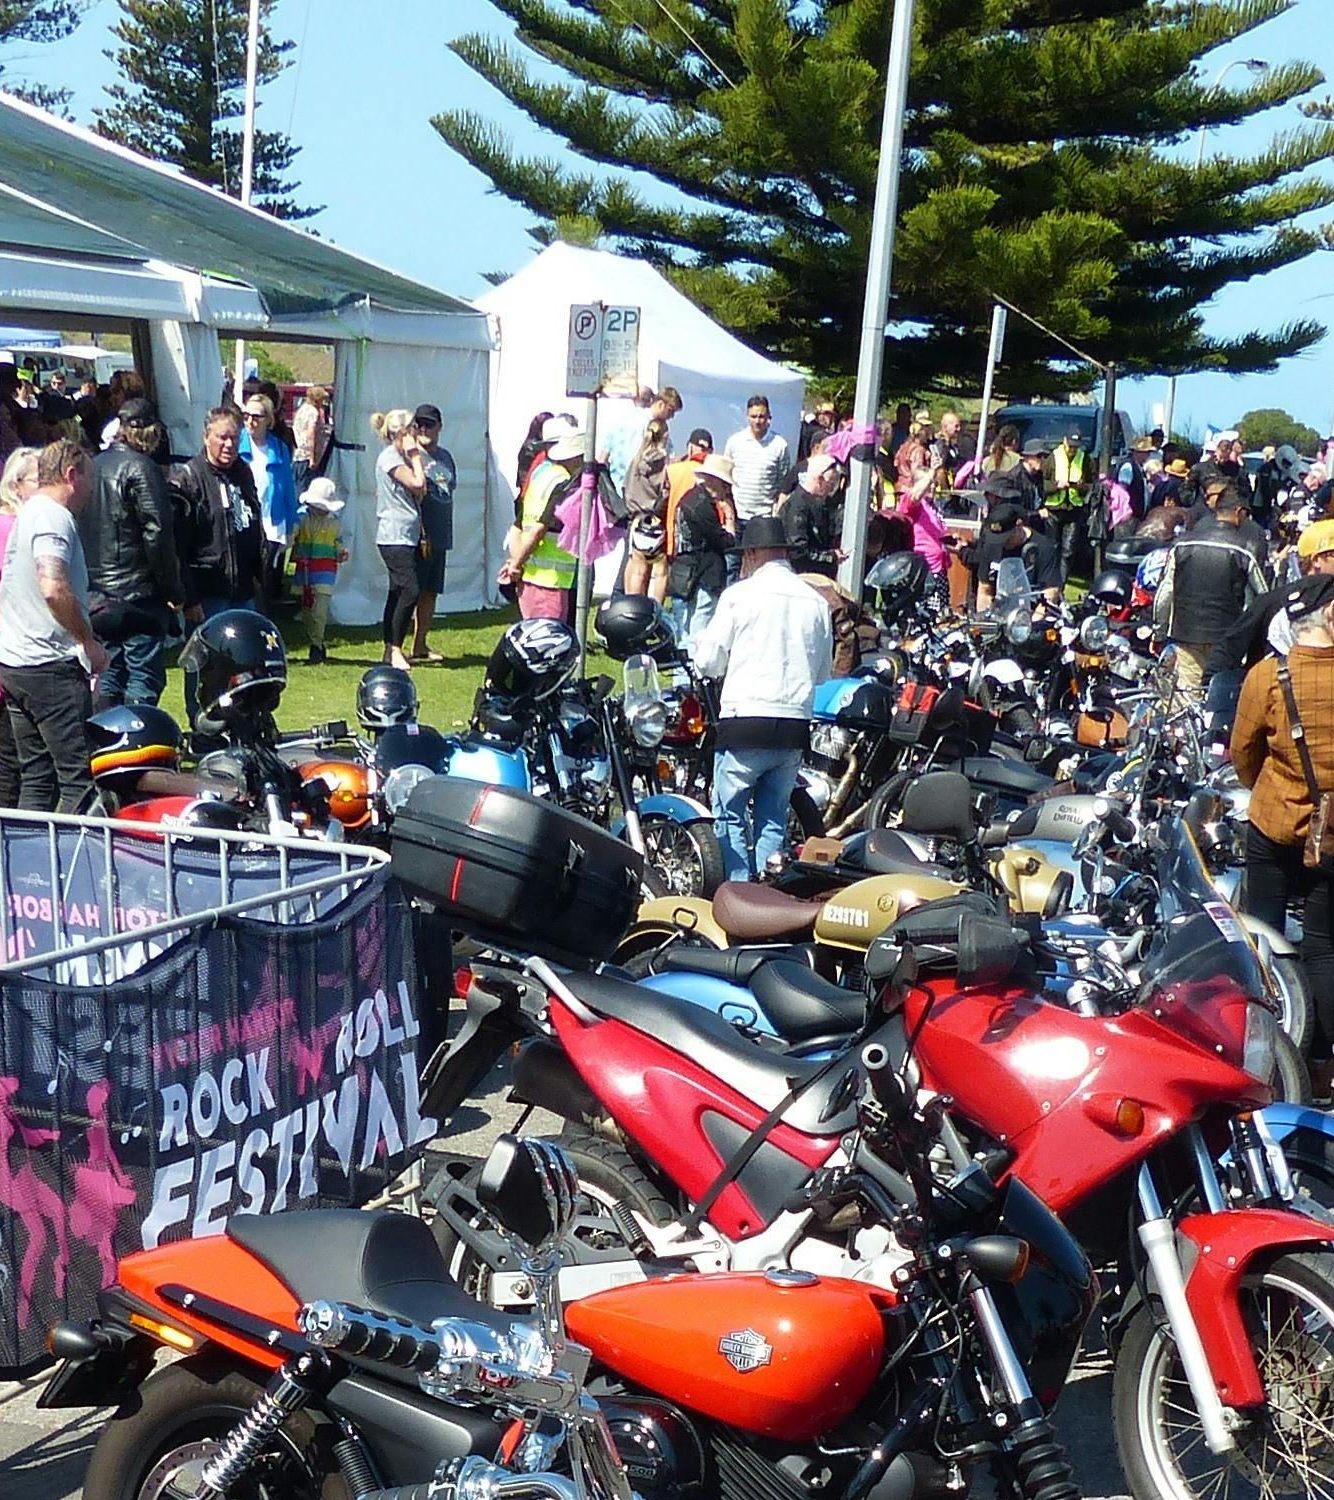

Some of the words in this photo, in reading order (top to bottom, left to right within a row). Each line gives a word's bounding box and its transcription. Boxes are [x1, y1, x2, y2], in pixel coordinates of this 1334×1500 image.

[607, 309, 638, 332] 2P
[141, 1051, 438, 1252] FESTIVAL
[159, 1047, 277, 1152] ROCK
[335, 980, 420, 1074] ROLL
